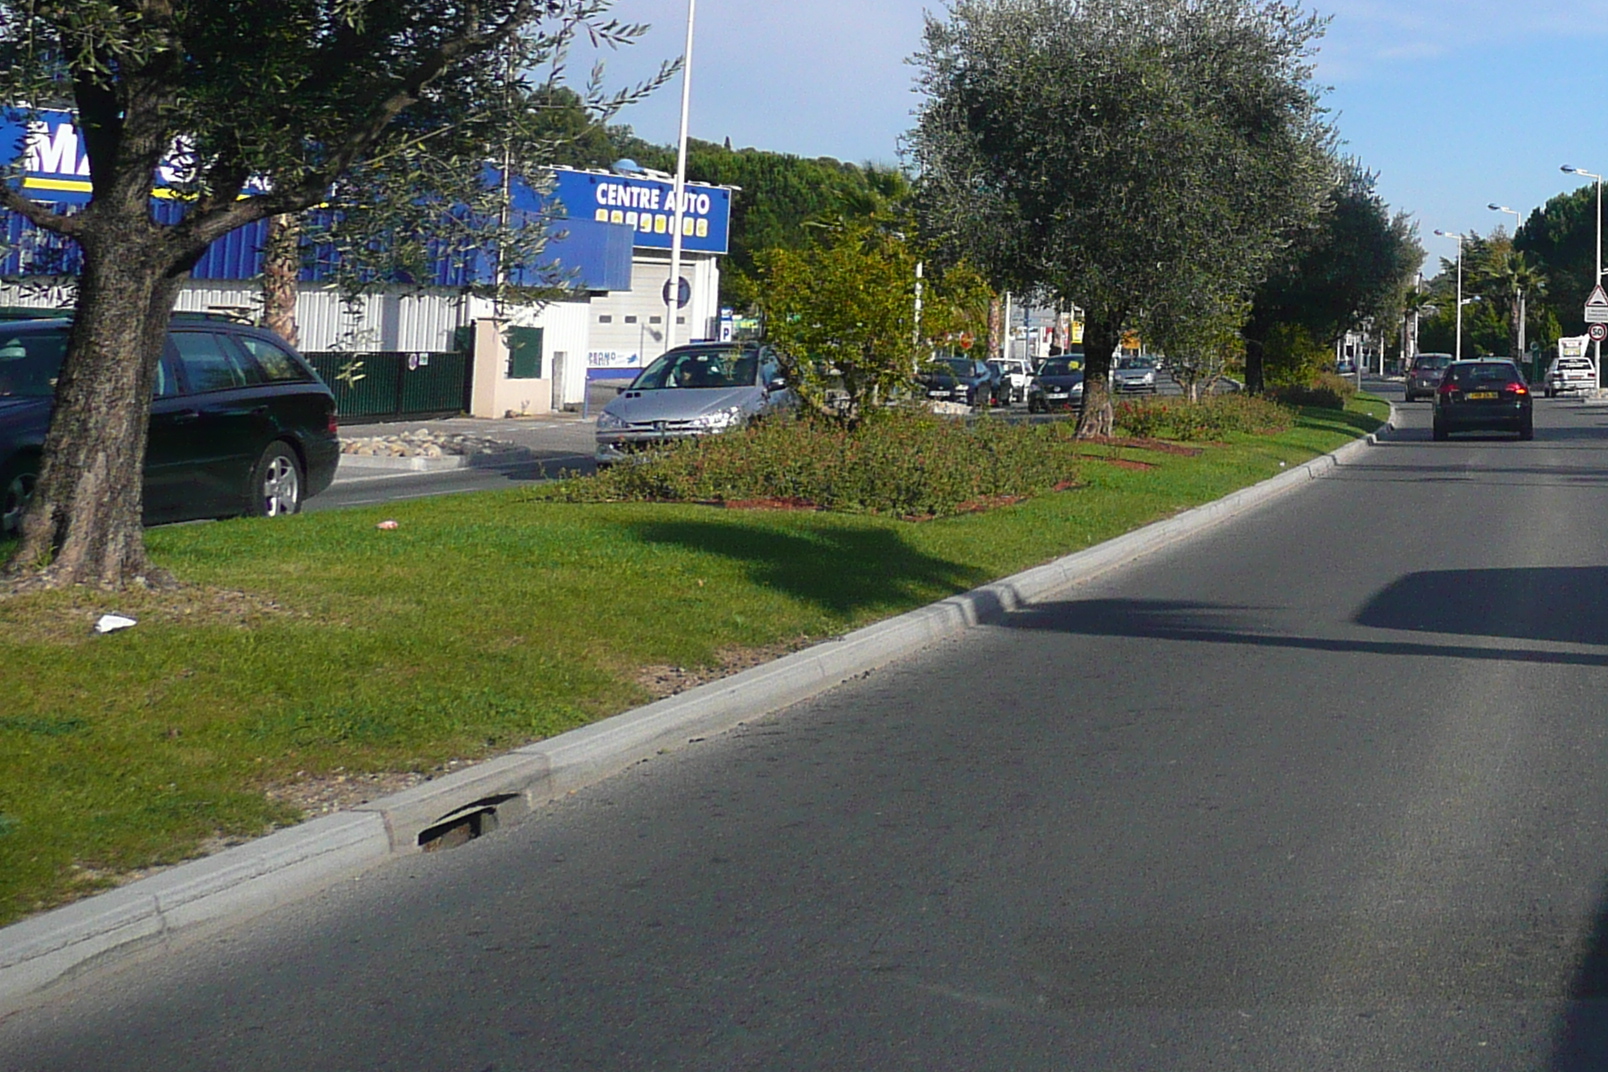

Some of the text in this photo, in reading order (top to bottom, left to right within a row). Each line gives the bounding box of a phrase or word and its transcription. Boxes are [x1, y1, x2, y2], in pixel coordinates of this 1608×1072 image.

[596, 182, 711, 215] CENTRE AUTO
[1592, 328, 1603, 336] 50
